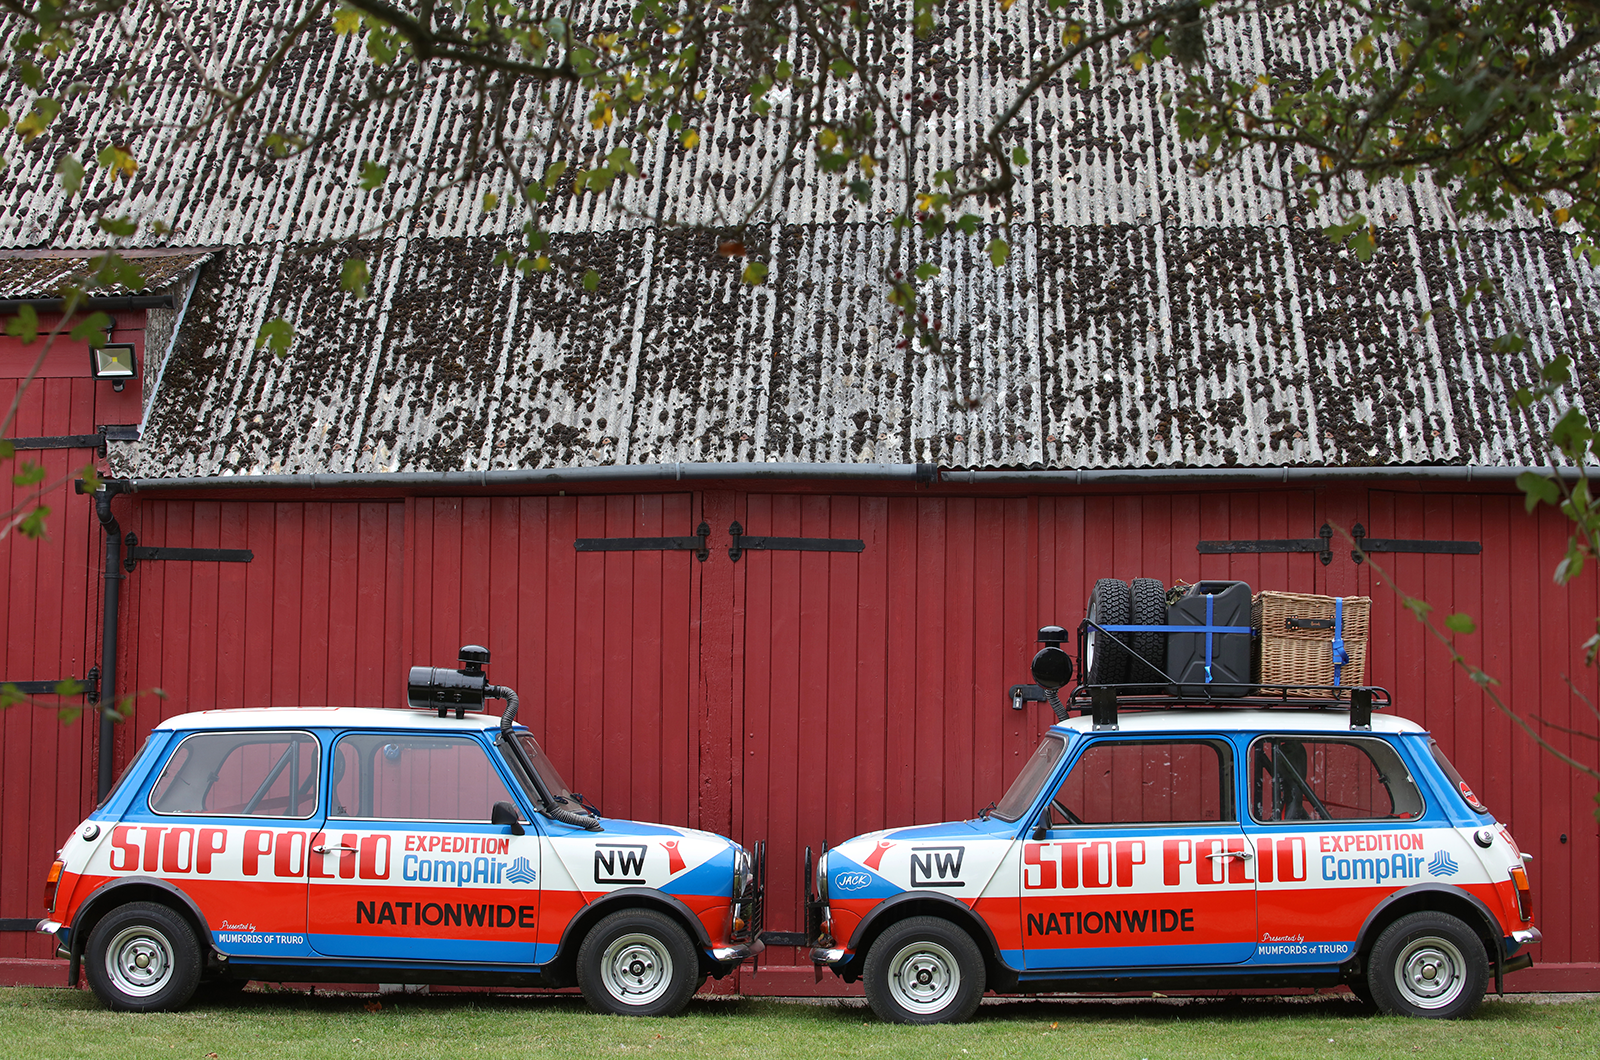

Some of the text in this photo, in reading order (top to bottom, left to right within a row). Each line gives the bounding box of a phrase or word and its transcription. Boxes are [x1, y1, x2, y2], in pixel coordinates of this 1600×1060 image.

[109, 826, 392, 880] STOP POLIO
[405, 835, 509, 855] EXPEDITION
[1319, 833, 1424, 853] EXPEDITION
[403, 854, 508, 887] CompAir
[594, 844, 648, 885] NW
[911, 846, 965, 887] NW
[1024, 836, 1306, 889] STOP POLIO
[1321, 853, 1424, 883] CompAir
[839, 875, 867, 886] JACK
[219, 919, 256, 934] Presented by
[356, 901, 535, 928] NATIONWIDE
[1026, 908, 1194, 936] NATIONWIDE
[219, 934, 304, 945] MUMFORDS OF TRURO
[1258, 944, 1348, 955] MUMFORDS of TRURO
[1261, 932, 1304, 944] Presented by
